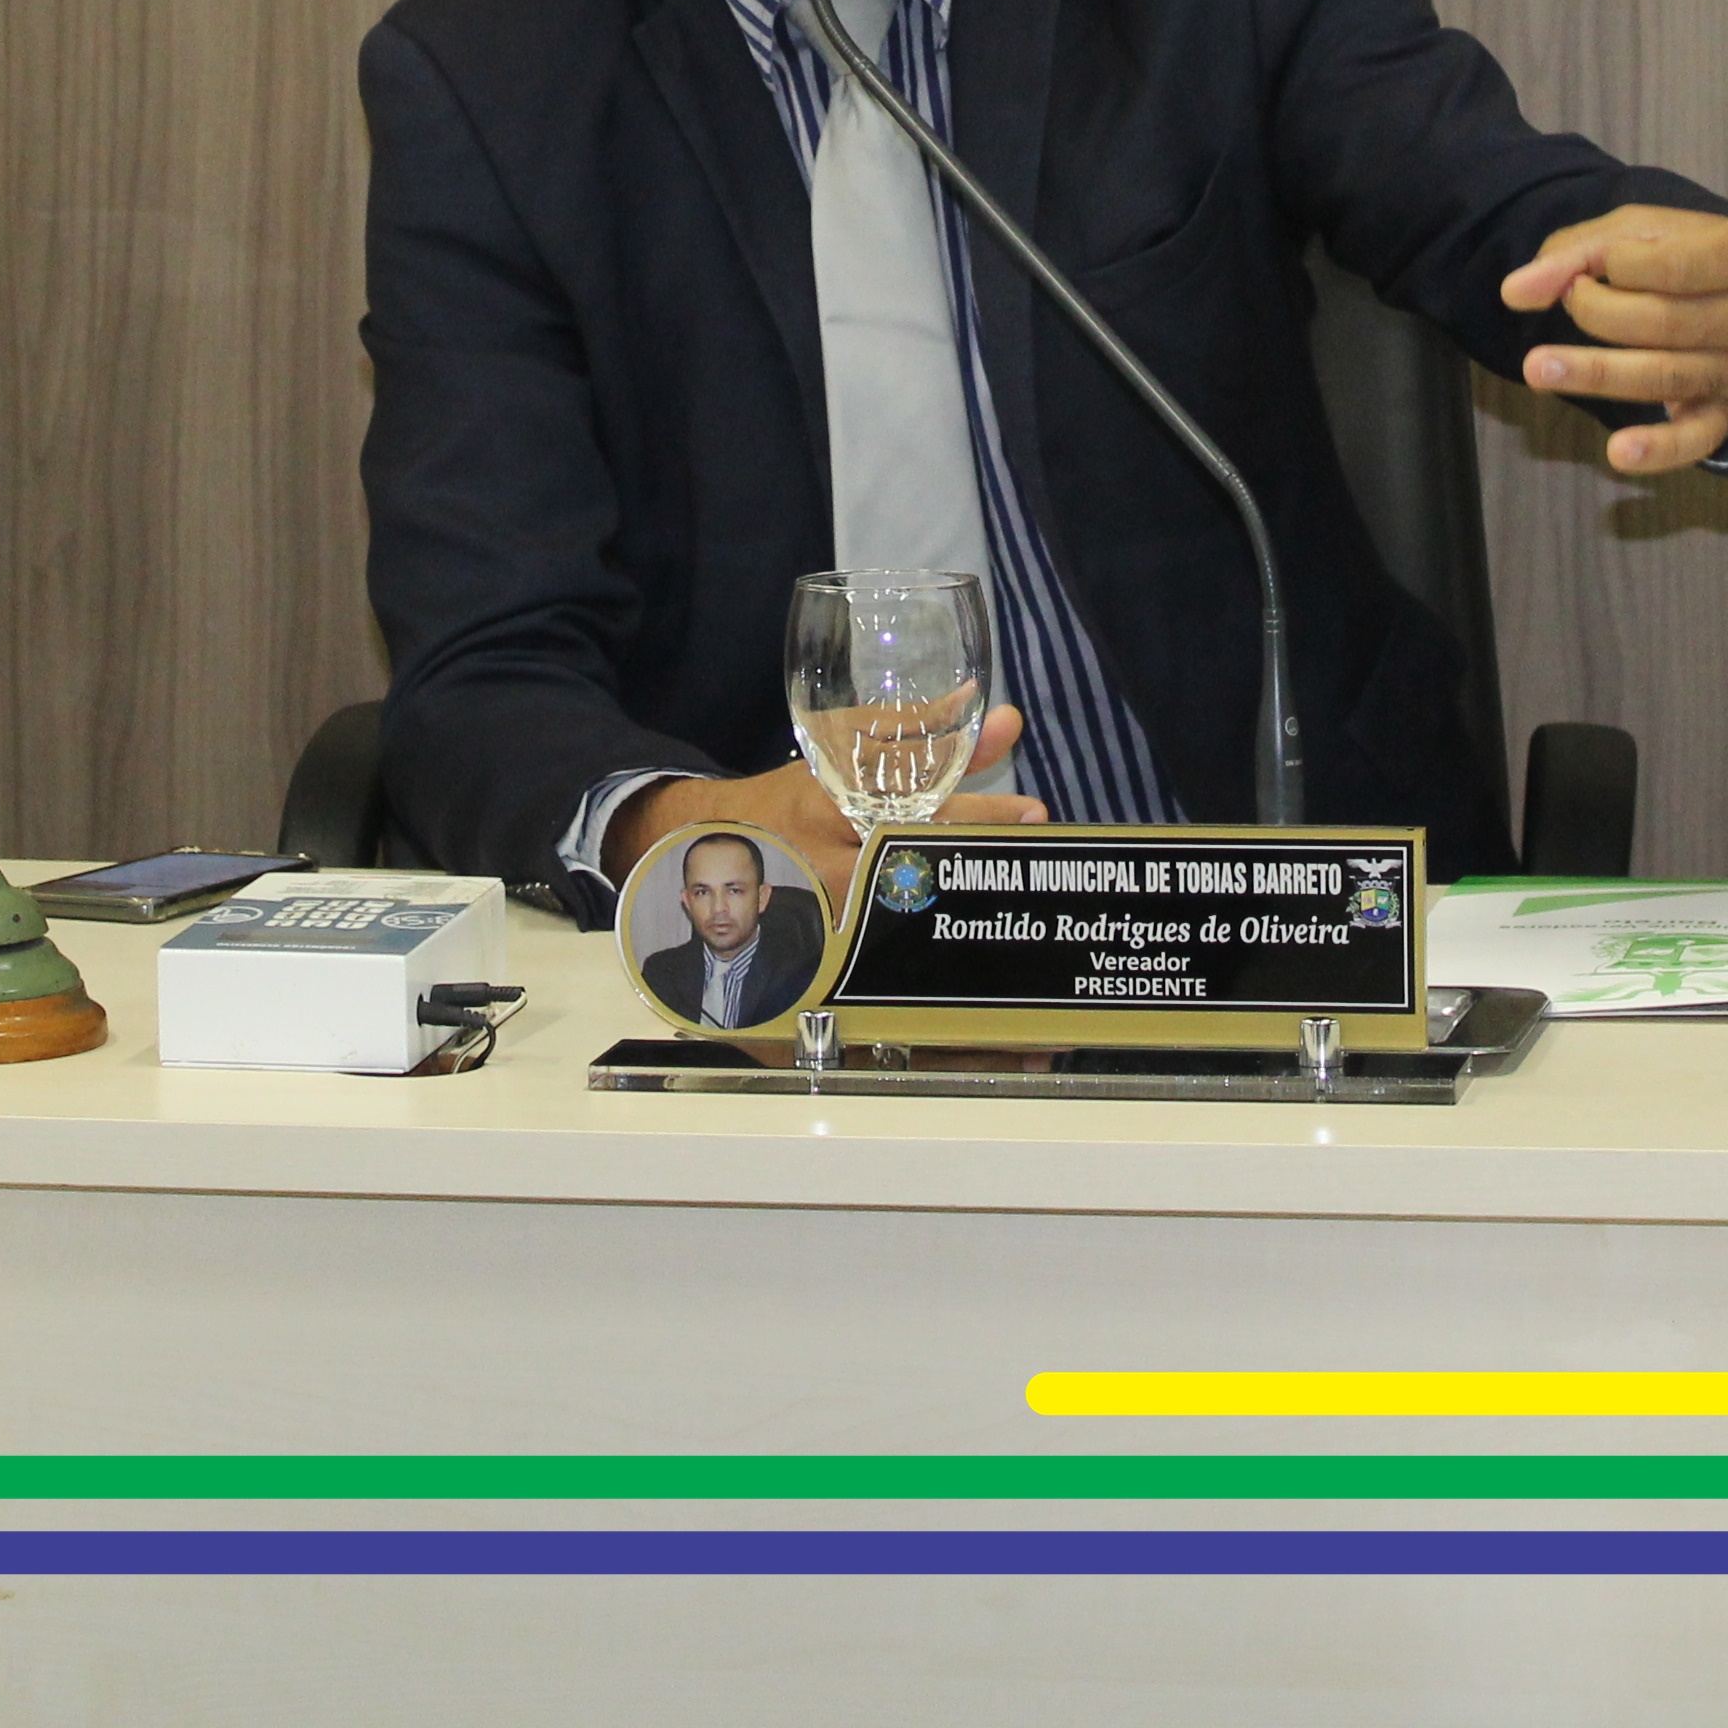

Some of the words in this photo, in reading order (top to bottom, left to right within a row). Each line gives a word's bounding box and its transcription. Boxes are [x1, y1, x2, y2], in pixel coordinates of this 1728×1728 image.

[938, 853, 1025, 893] CÂMARA
[1029, 859, 1141, 894] MUNICIPAL
[1144, 860, 1172, 894] DE
[1174, 860, 1247, 895] TOBIAS
[1252, 862, 1343, 896] BARRETO
[933, 913, 1047, 942] Romildo
[1054, 914, 1191, 950] Rodrigues
[1199, 916, 1232, 944] de
[1239, 916, 1350, 946] Oliveira
[1089, 952, 1191, 972] Vereador
[1073, 976, 1207, 998] PRESIDENTE
